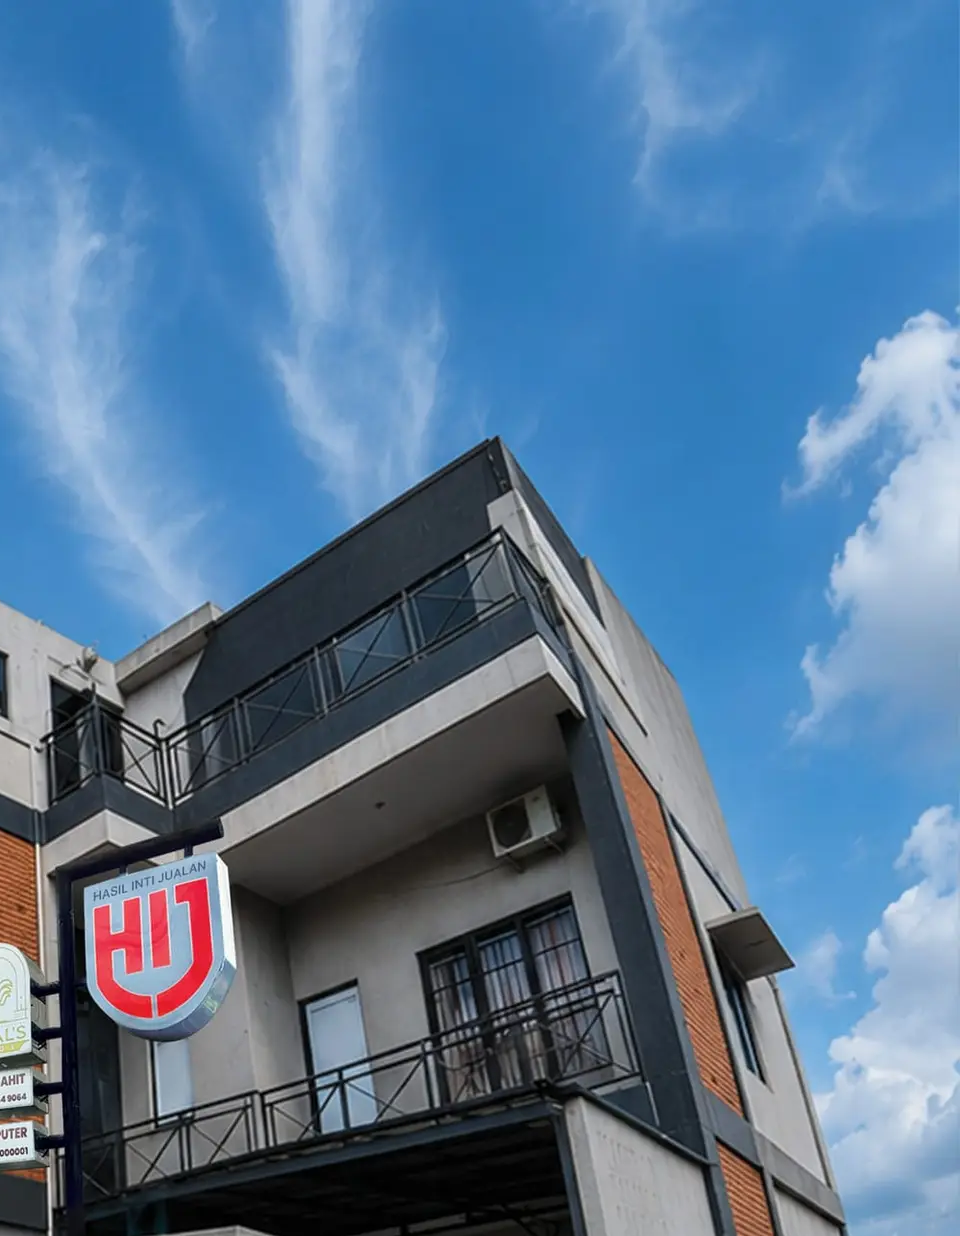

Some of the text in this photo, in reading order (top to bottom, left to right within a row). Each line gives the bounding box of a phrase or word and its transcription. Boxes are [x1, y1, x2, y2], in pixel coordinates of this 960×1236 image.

[93, 860, 207, 901] HASIL INTI JUALAN
